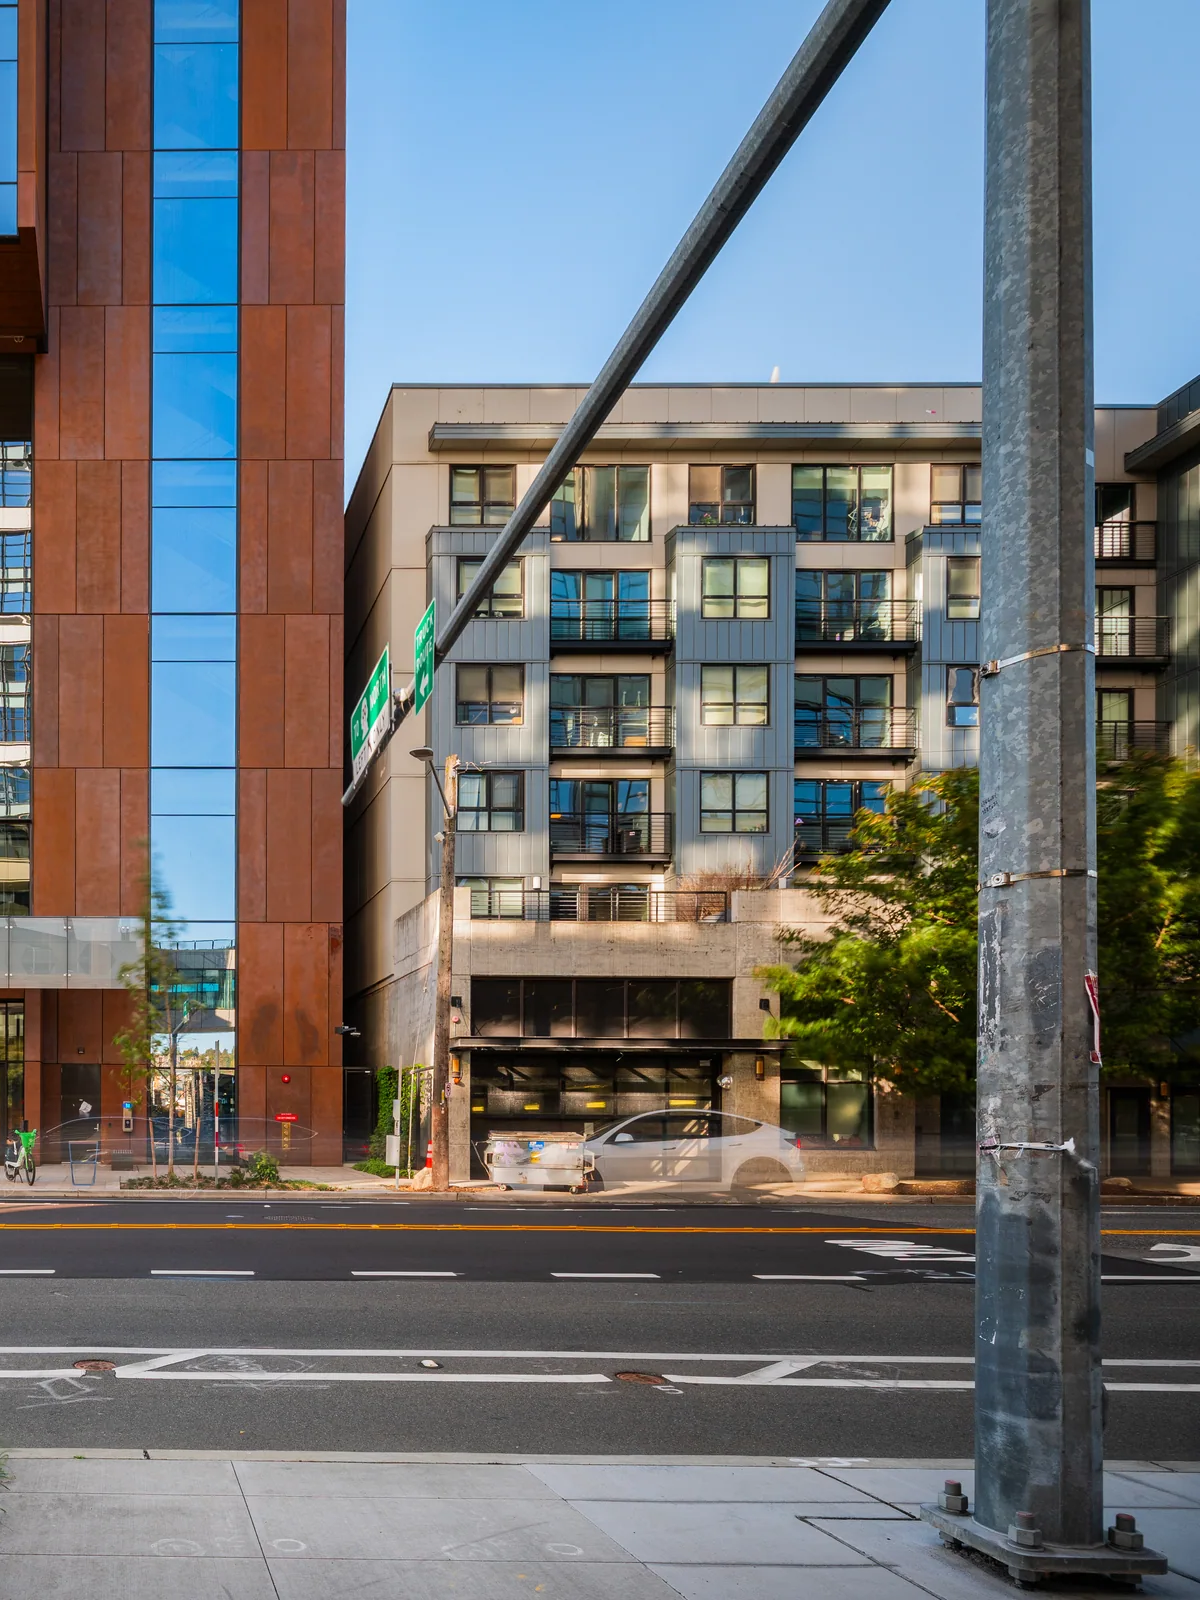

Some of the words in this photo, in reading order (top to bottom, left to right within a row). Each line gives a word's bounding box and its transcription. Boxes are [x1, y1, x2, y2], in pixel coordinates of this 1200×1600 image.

[416, 611, 433, 649] TRUCK
[416, 636, 433, 674] ROUTE
[369, 666, 386, 711] NORTH
